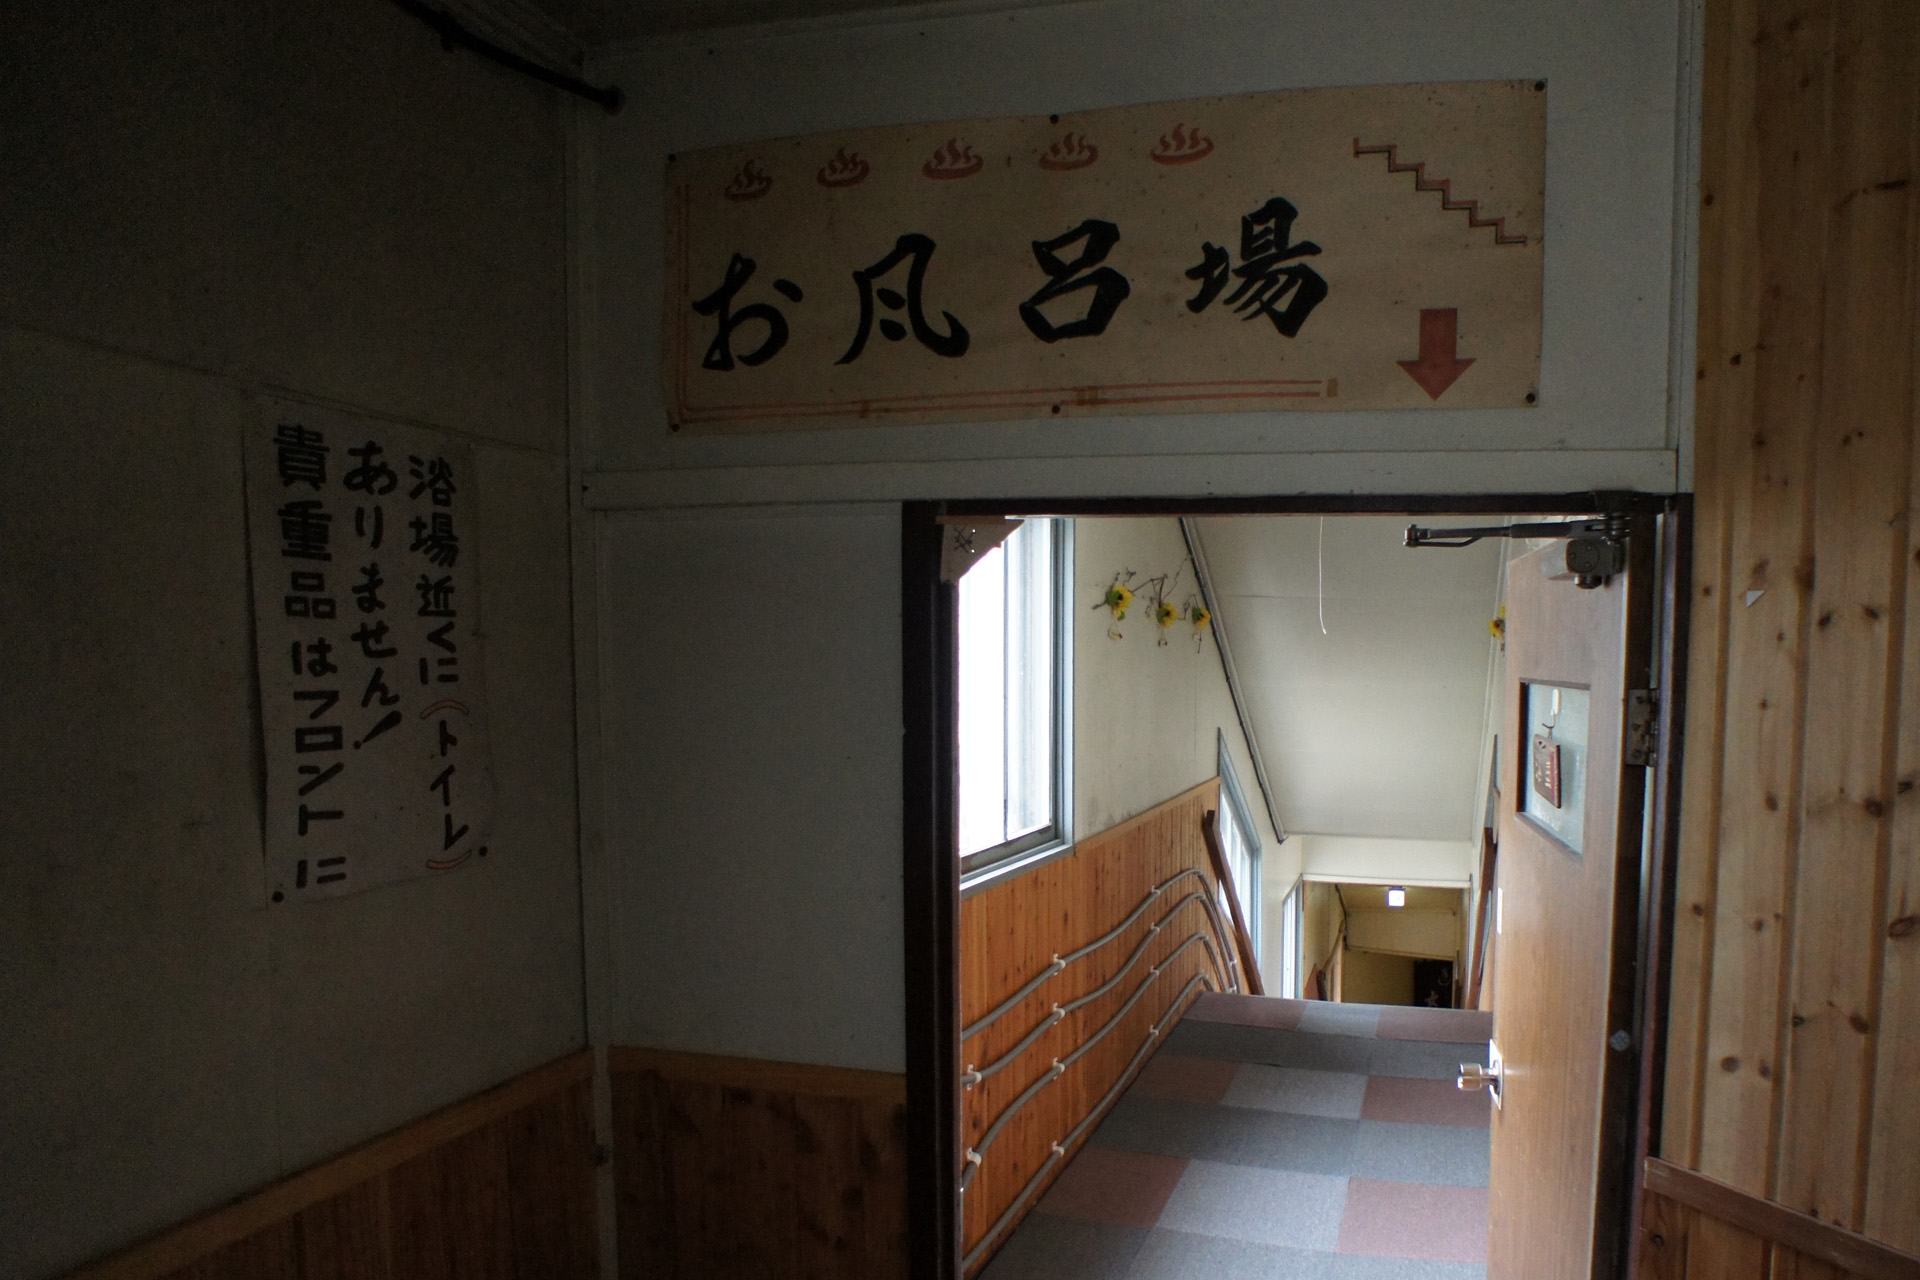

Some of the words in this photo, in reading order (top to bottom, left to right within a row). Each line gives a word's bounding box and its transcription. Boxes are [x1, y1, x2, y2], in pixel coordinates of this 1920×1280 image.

[693, 197, 1328, 371] お風呂場
[273, 424, 347, 888] 貴重品はフロントに
